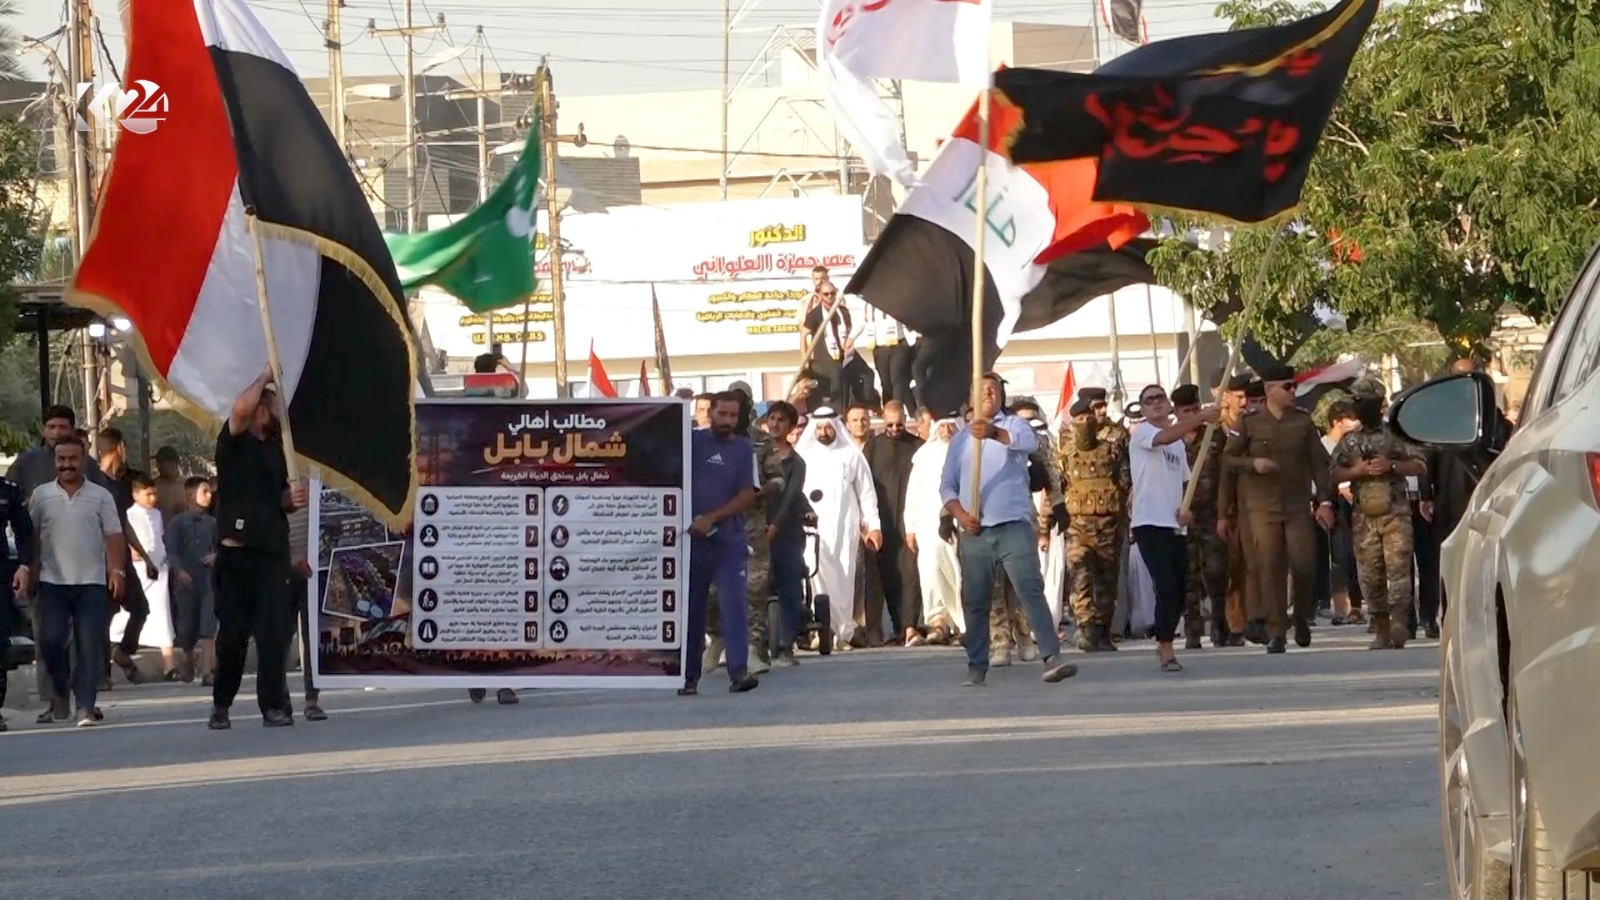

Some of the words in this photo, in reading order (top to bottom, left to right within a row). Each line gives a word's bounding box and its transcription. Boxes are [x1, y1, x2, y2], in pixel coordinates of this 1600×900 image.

[749, 223, 806, 247] الدكتور
[776, 253, 818, 275] حمزة
[508, 410, 550, 435] أهالي
[553, 414, 606, 434] مطالب
[484, 432, 549, 465] بابل
[553, 431, 627, 464] شمال
[501, 470, 528, 482] الكريمة
[529, 471, 548, 480] الحياة
[551, 471, 574, 482] يستحق
[576, 471, 588, 482] بابل
[590, 470, 610, 481] شمال
